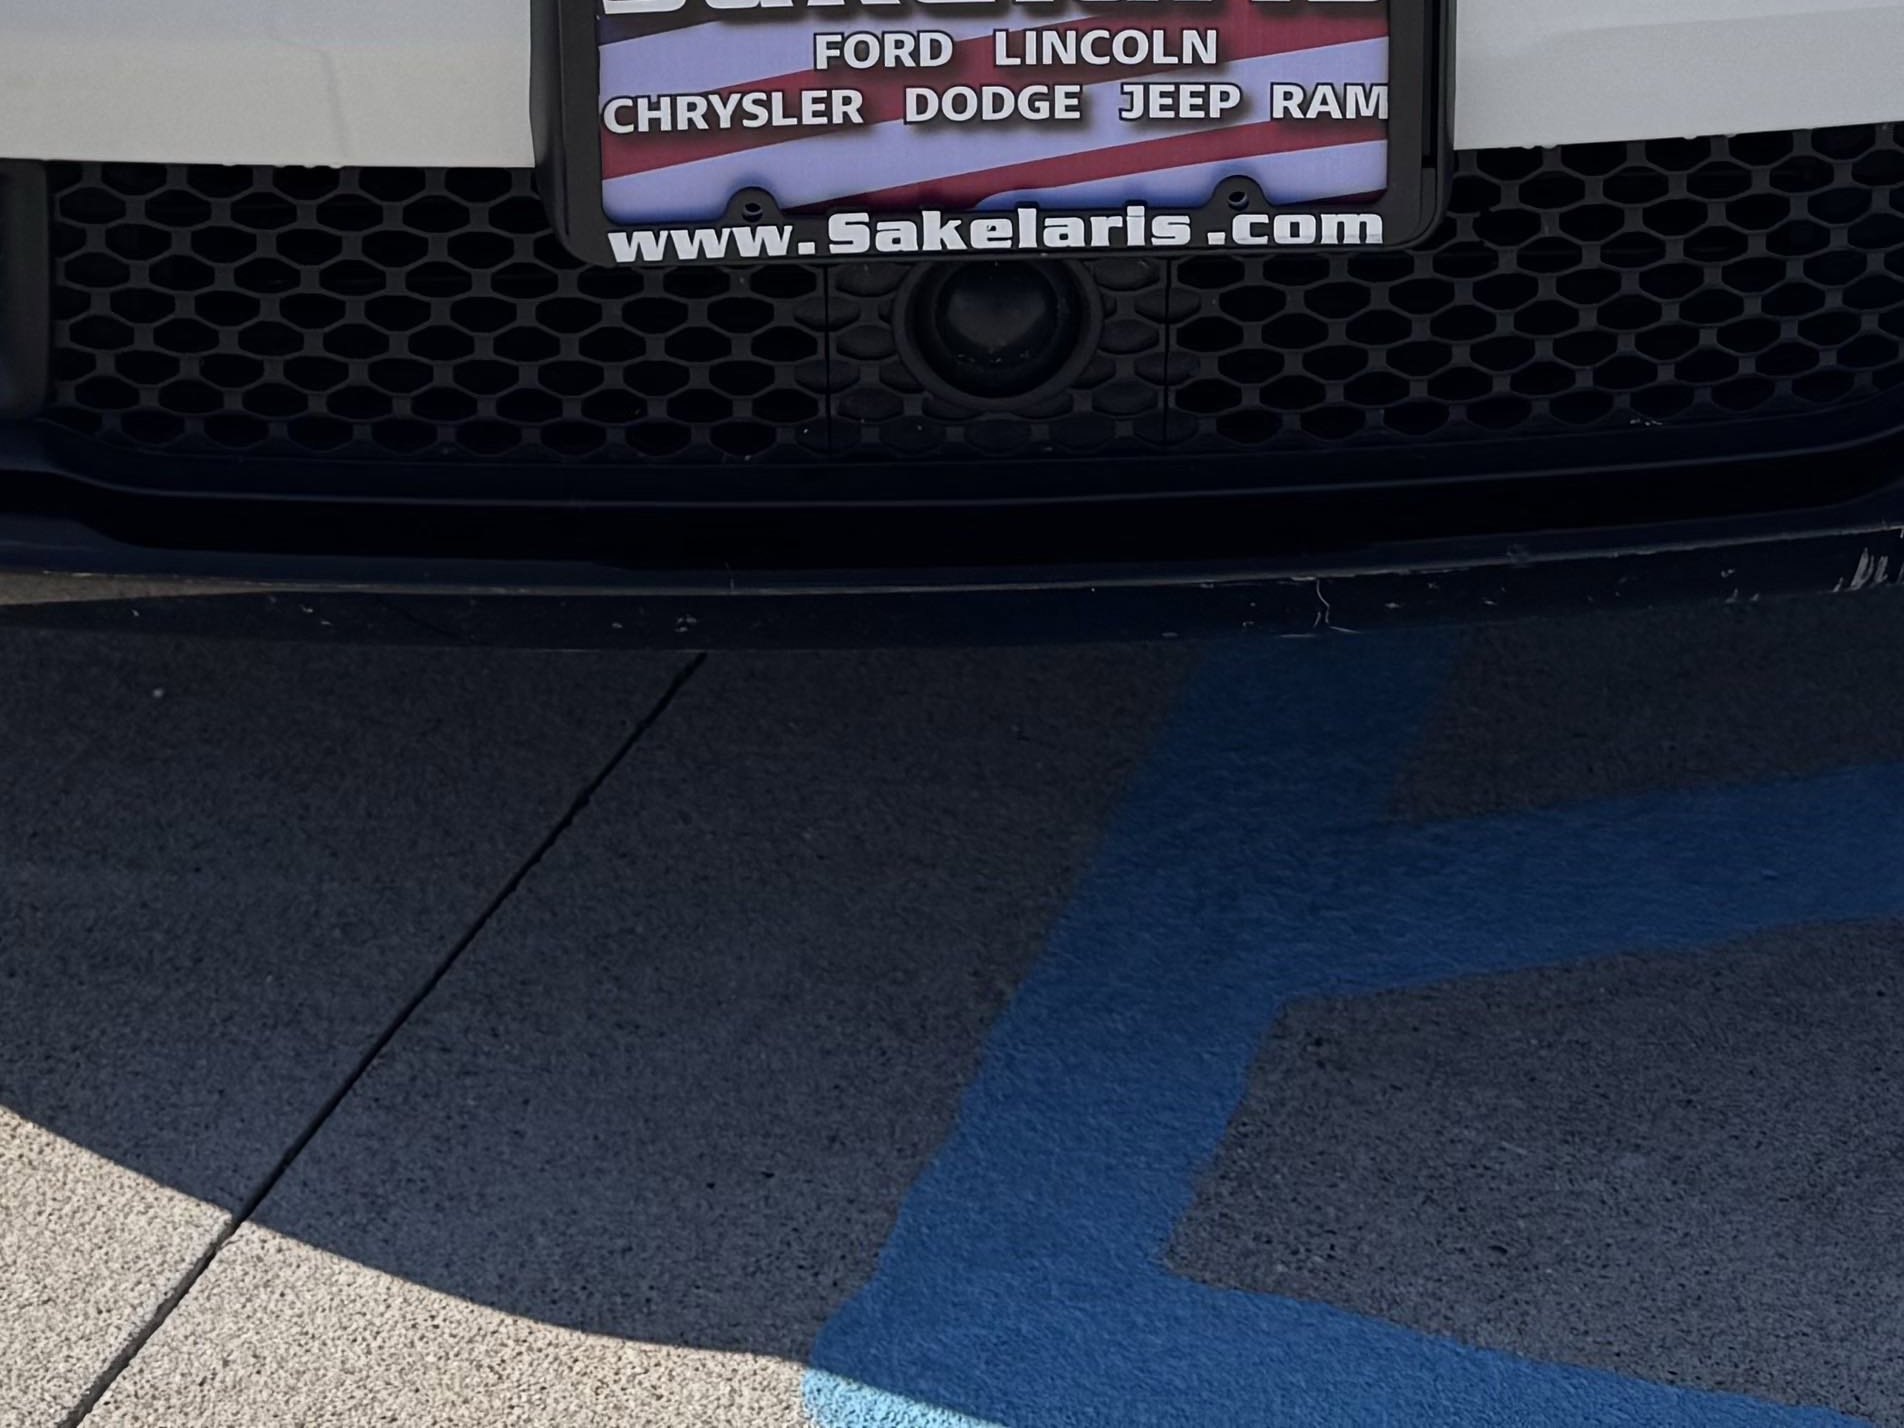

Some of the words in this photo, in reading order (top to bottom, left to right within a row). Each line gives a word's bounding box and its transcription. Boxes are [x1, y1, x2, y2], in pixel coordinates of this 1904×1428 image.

[815, 32, 953, 70] FORD
[995, 29, 1217, 66] LINCOLN
[603, 89, 864, 134] CHRYSLER
[904, 84, 1082, 122] DODGE
[1120, 83, 1242, 120] JEEP
[1271, 83, 1389, 120] RAM
